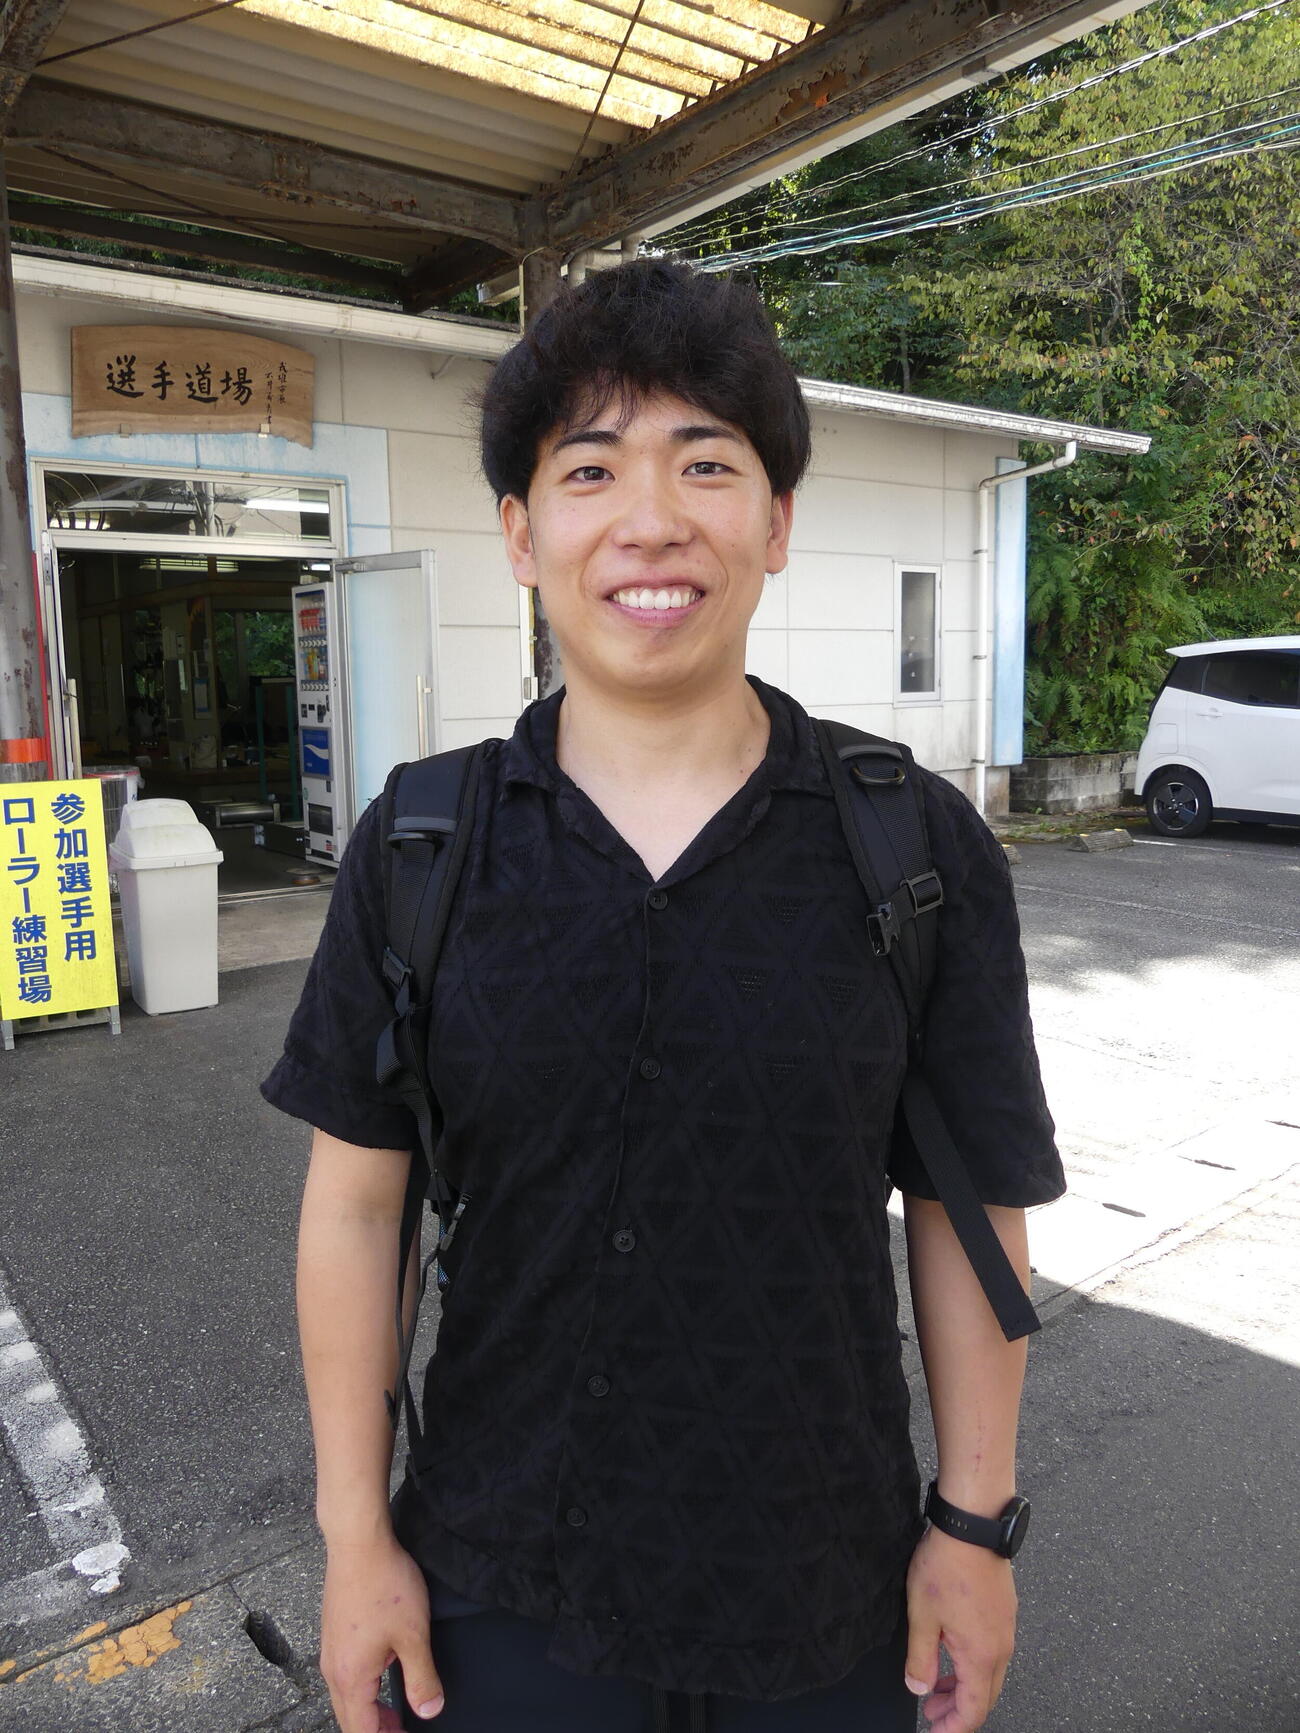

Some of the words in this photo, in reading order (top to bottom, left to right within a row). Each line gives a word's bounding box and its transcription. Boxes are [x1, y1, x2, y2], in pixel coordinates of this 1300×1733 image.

[106, 354, 253, 405] 選手道場
[3, 798, 52, 1003] ローラー練習場
[52, 793, 97, 962] 参加選手用
